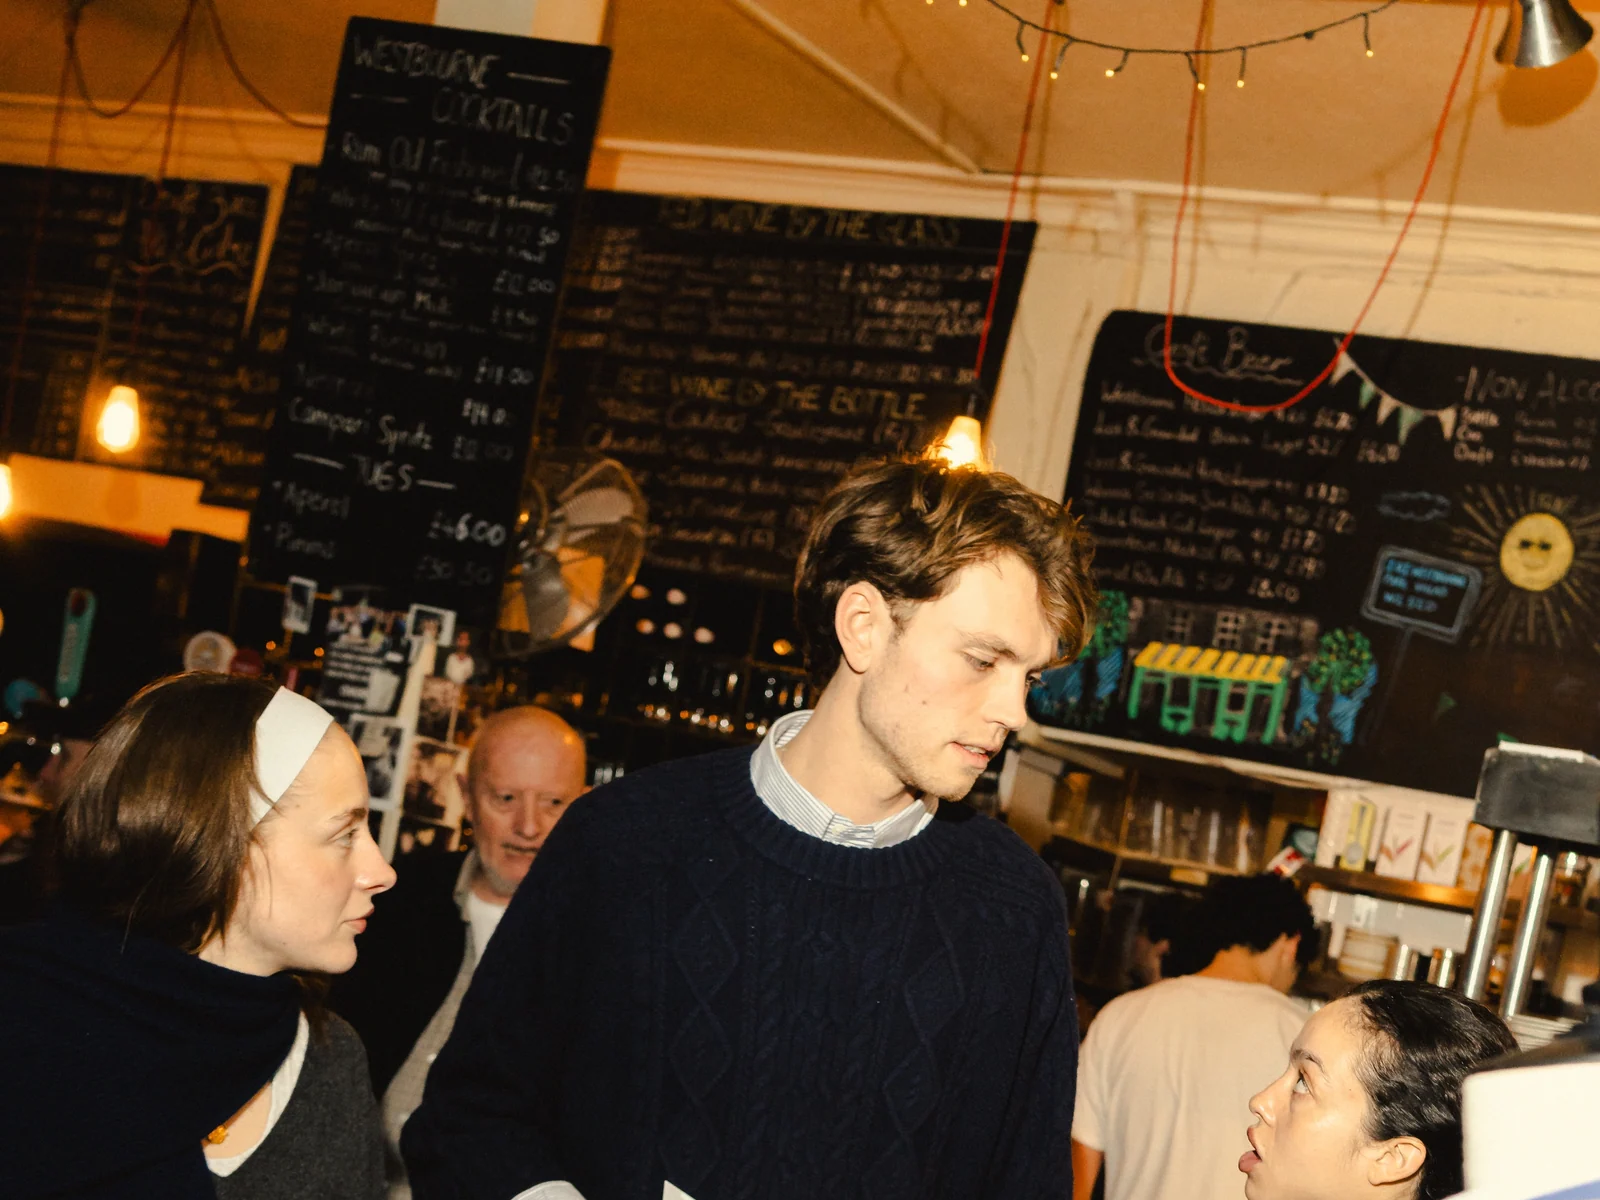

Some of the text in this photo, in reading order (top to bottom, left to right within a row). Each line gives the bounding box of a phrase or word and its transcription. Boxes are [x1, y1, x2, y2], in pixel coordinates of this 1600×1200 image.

[355, 35, 500, 89] WESTBOURNE
[431, 87, 575, 146] COCKTAILS
[822, 209, 873, 239] THE
[1224, 325, 1294, 373] Beer
[776, 380, 822, 411] THE
[829, 384, 928, 420] BOTTLE
